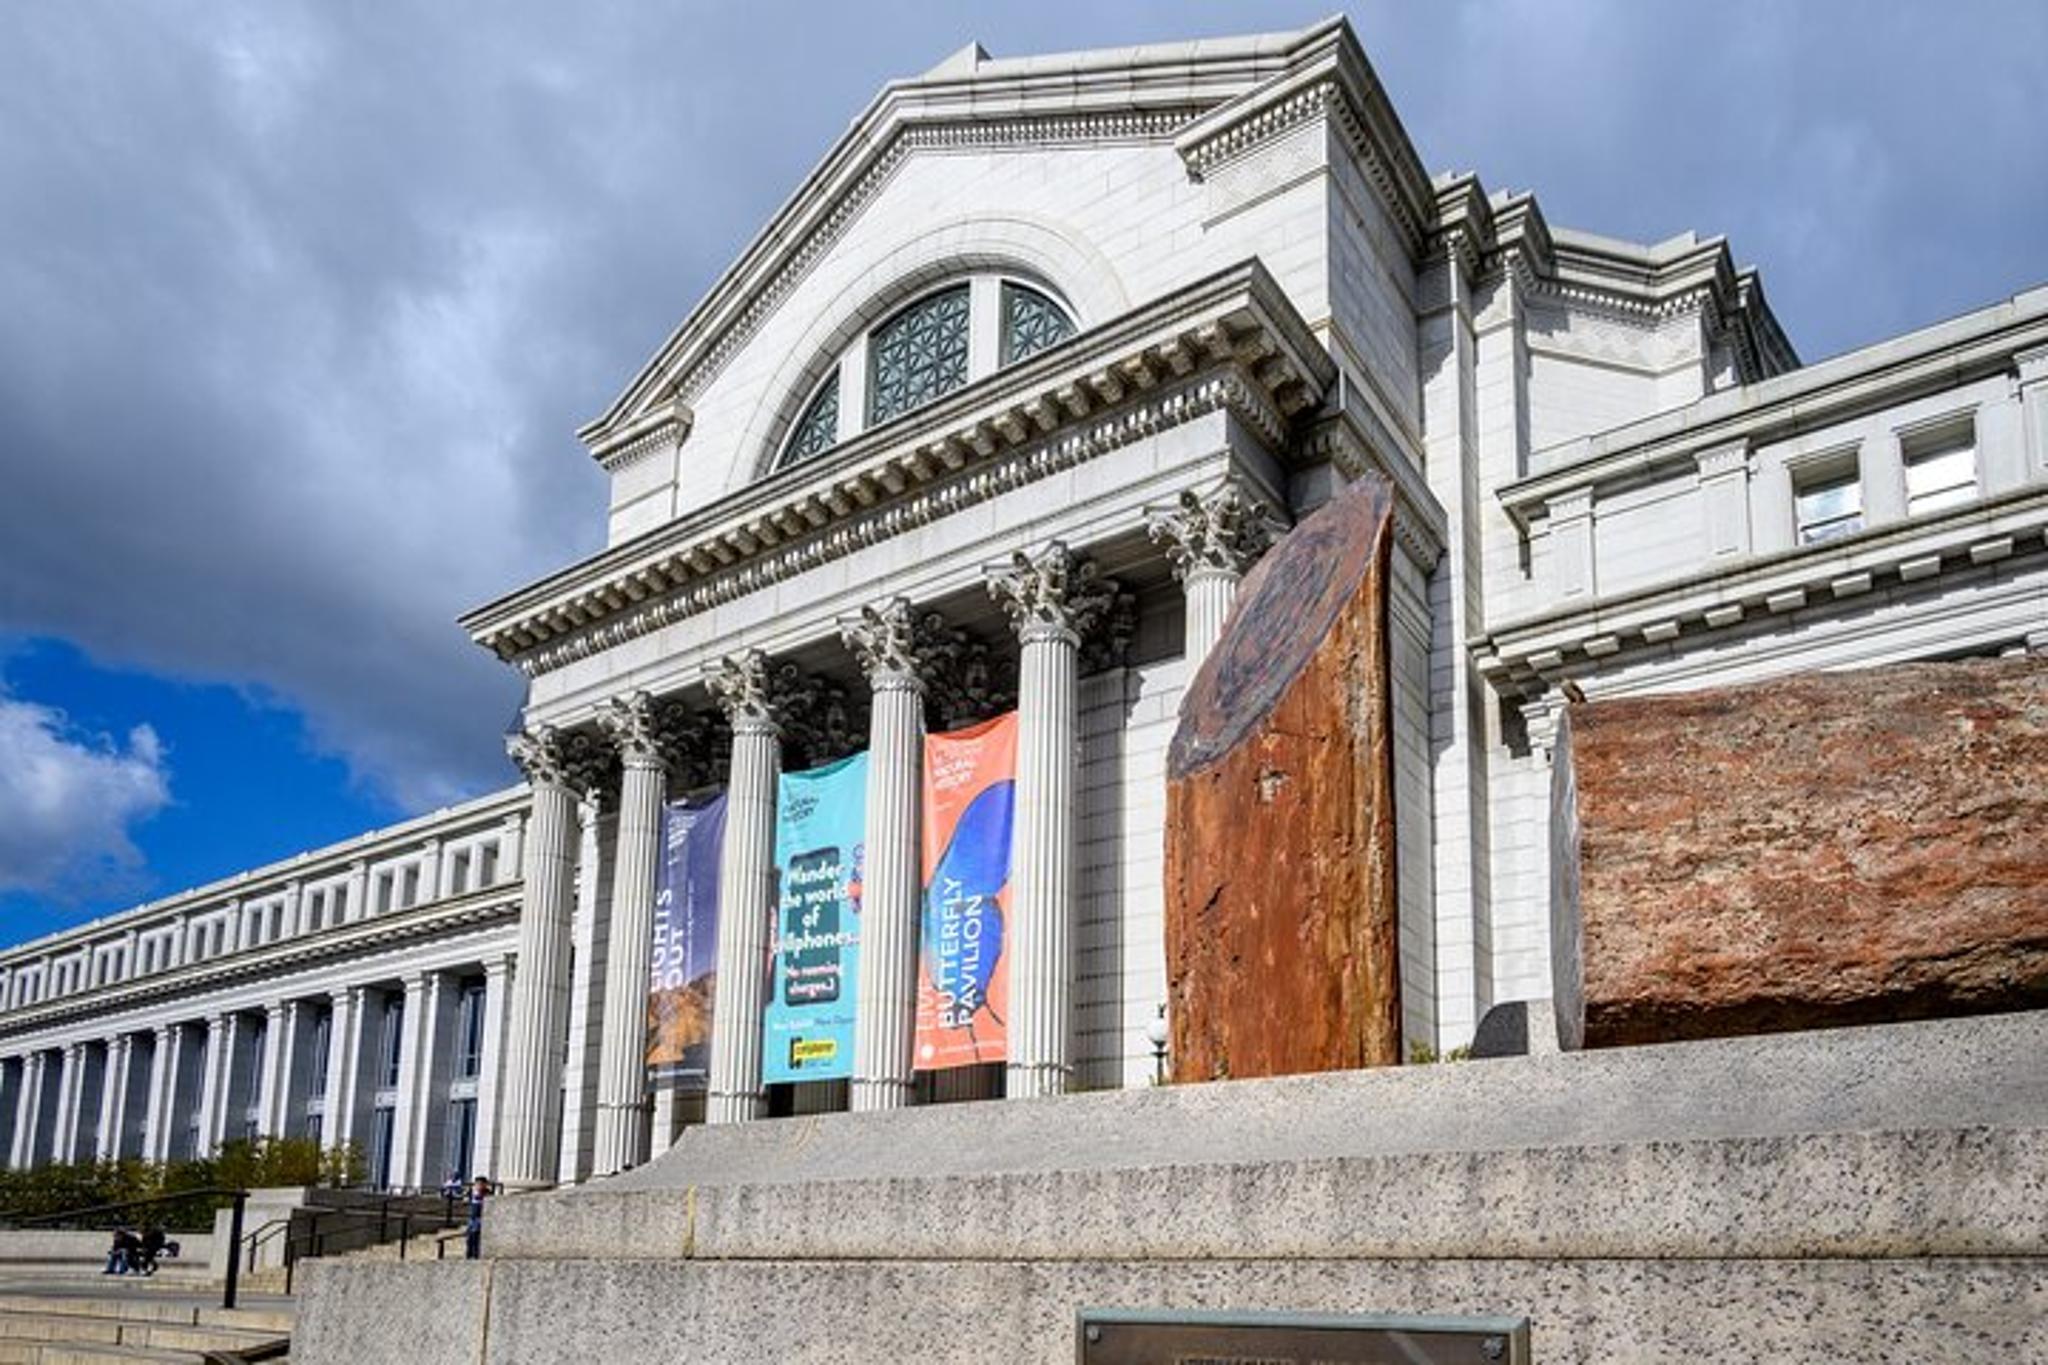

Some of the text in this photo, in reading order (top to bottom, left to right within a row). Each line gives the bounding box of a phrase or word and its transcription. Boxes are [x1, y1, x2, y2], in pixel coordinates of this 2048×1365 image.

[802, 905, 820, 927] of
[805, 879, 849, 903] world
[665, 926, 683, 990] OUT
[938, 877, 962, 1029] BUTTERFLY
[958, 894, 982, 1026] PAVILION
